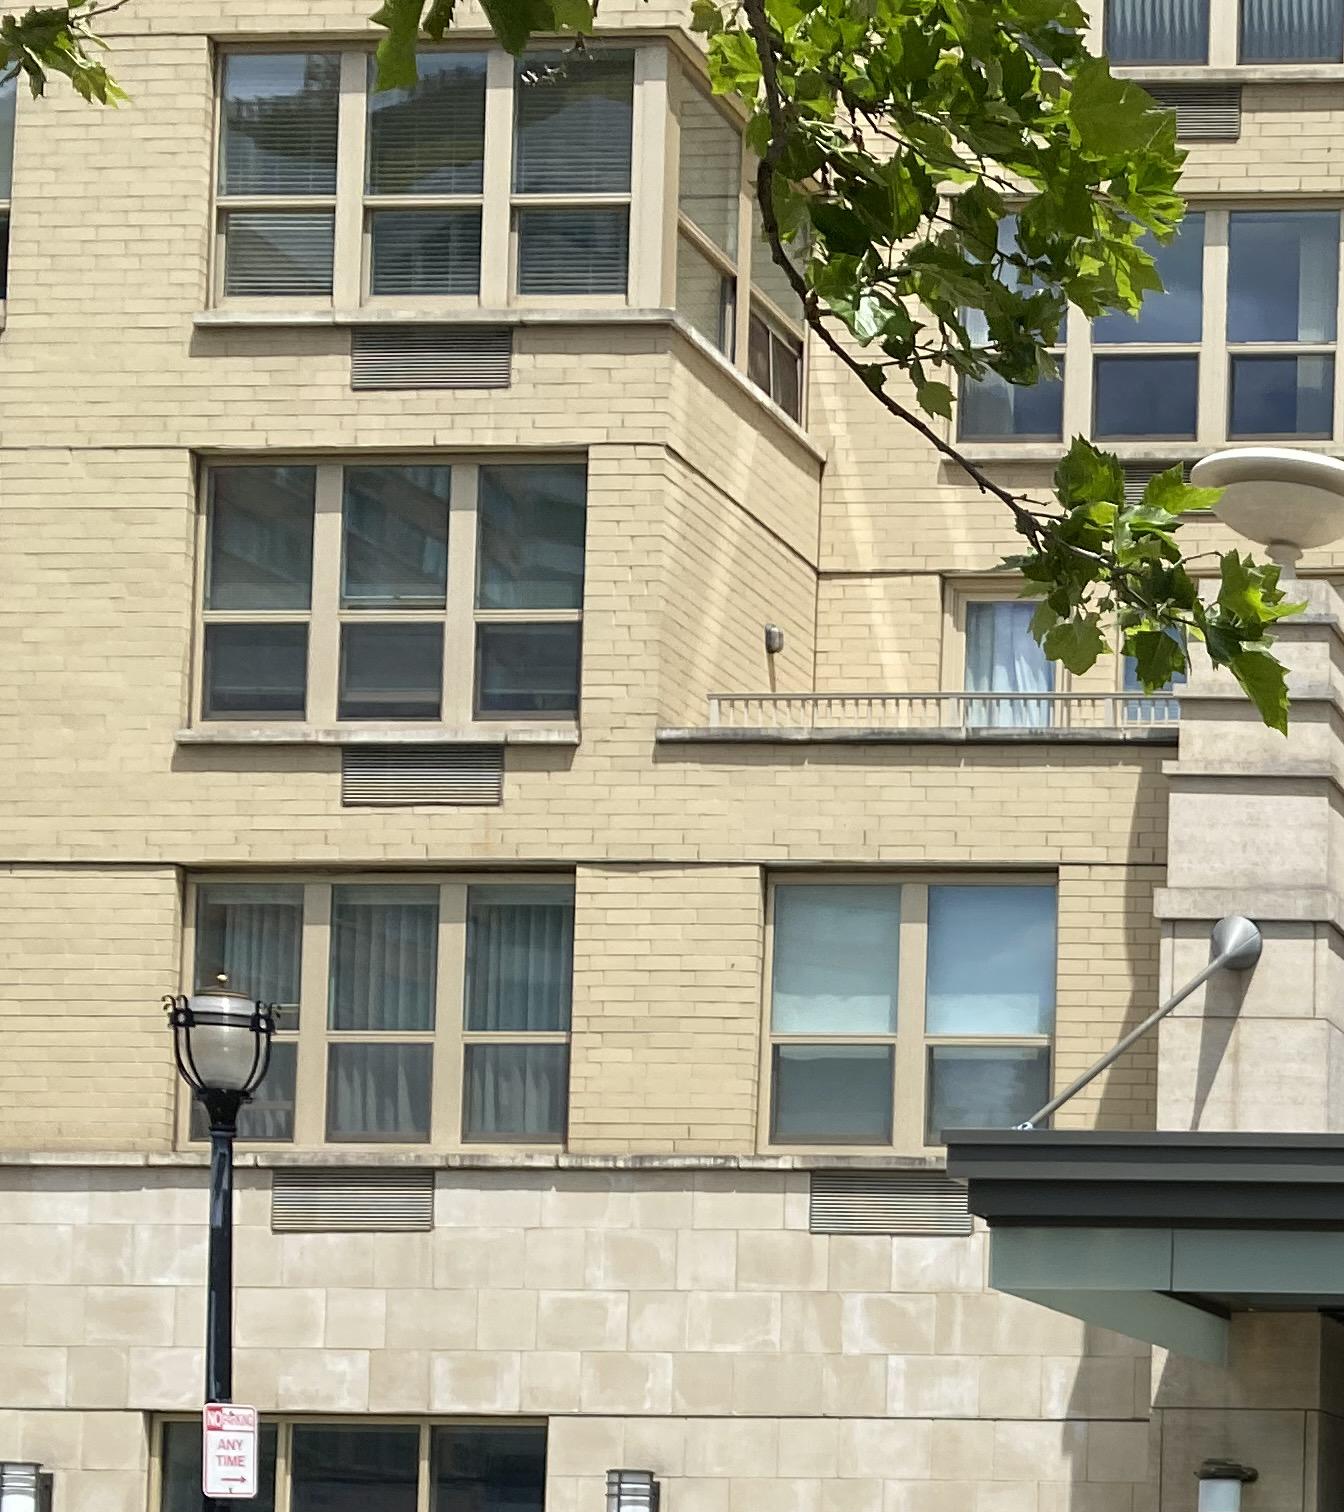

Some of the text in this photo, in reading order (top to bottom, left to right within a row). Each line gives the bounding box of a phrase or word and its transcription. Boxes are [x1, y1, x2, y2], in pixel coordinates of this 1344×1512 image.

[207, 1411, 223, 1427] NO
[217, 1439, 244, 1451] ANY
[215, 1455, 246, 1467] TIME
